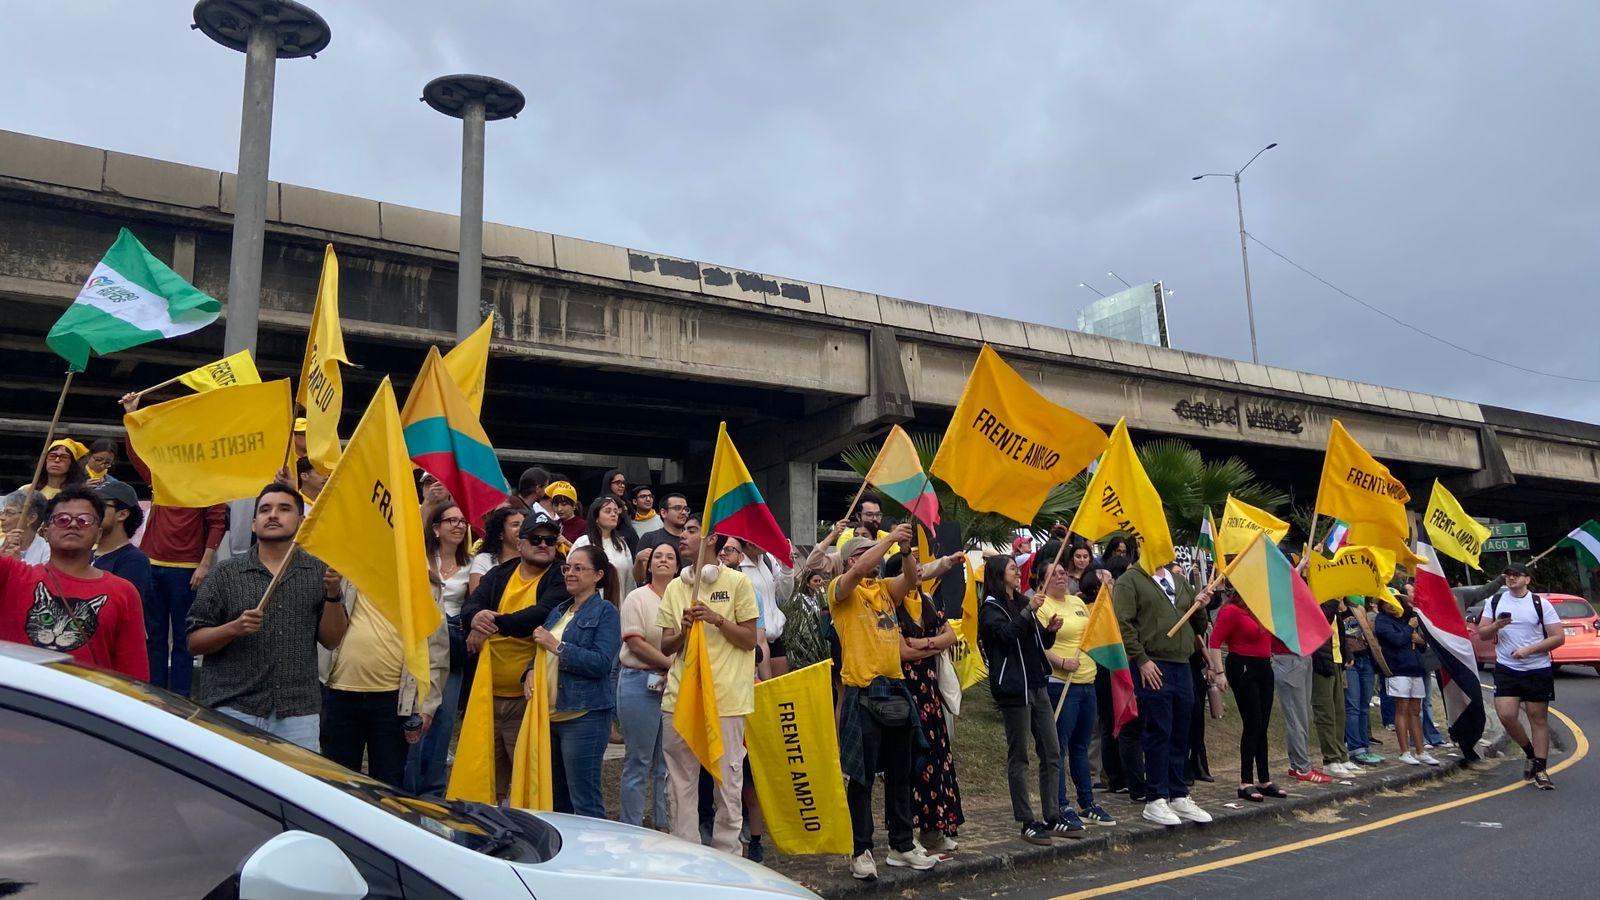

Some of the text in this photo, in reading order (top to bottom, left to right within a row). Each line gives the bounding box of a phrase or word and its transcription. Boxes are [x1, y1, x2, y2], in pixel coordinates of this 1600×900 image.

[972, 407, 1028, 461] FRENTE
[1346, 466, 1387, 496] FRENTE
[778, 702, 821, 832] FRENTE AMPLIO
